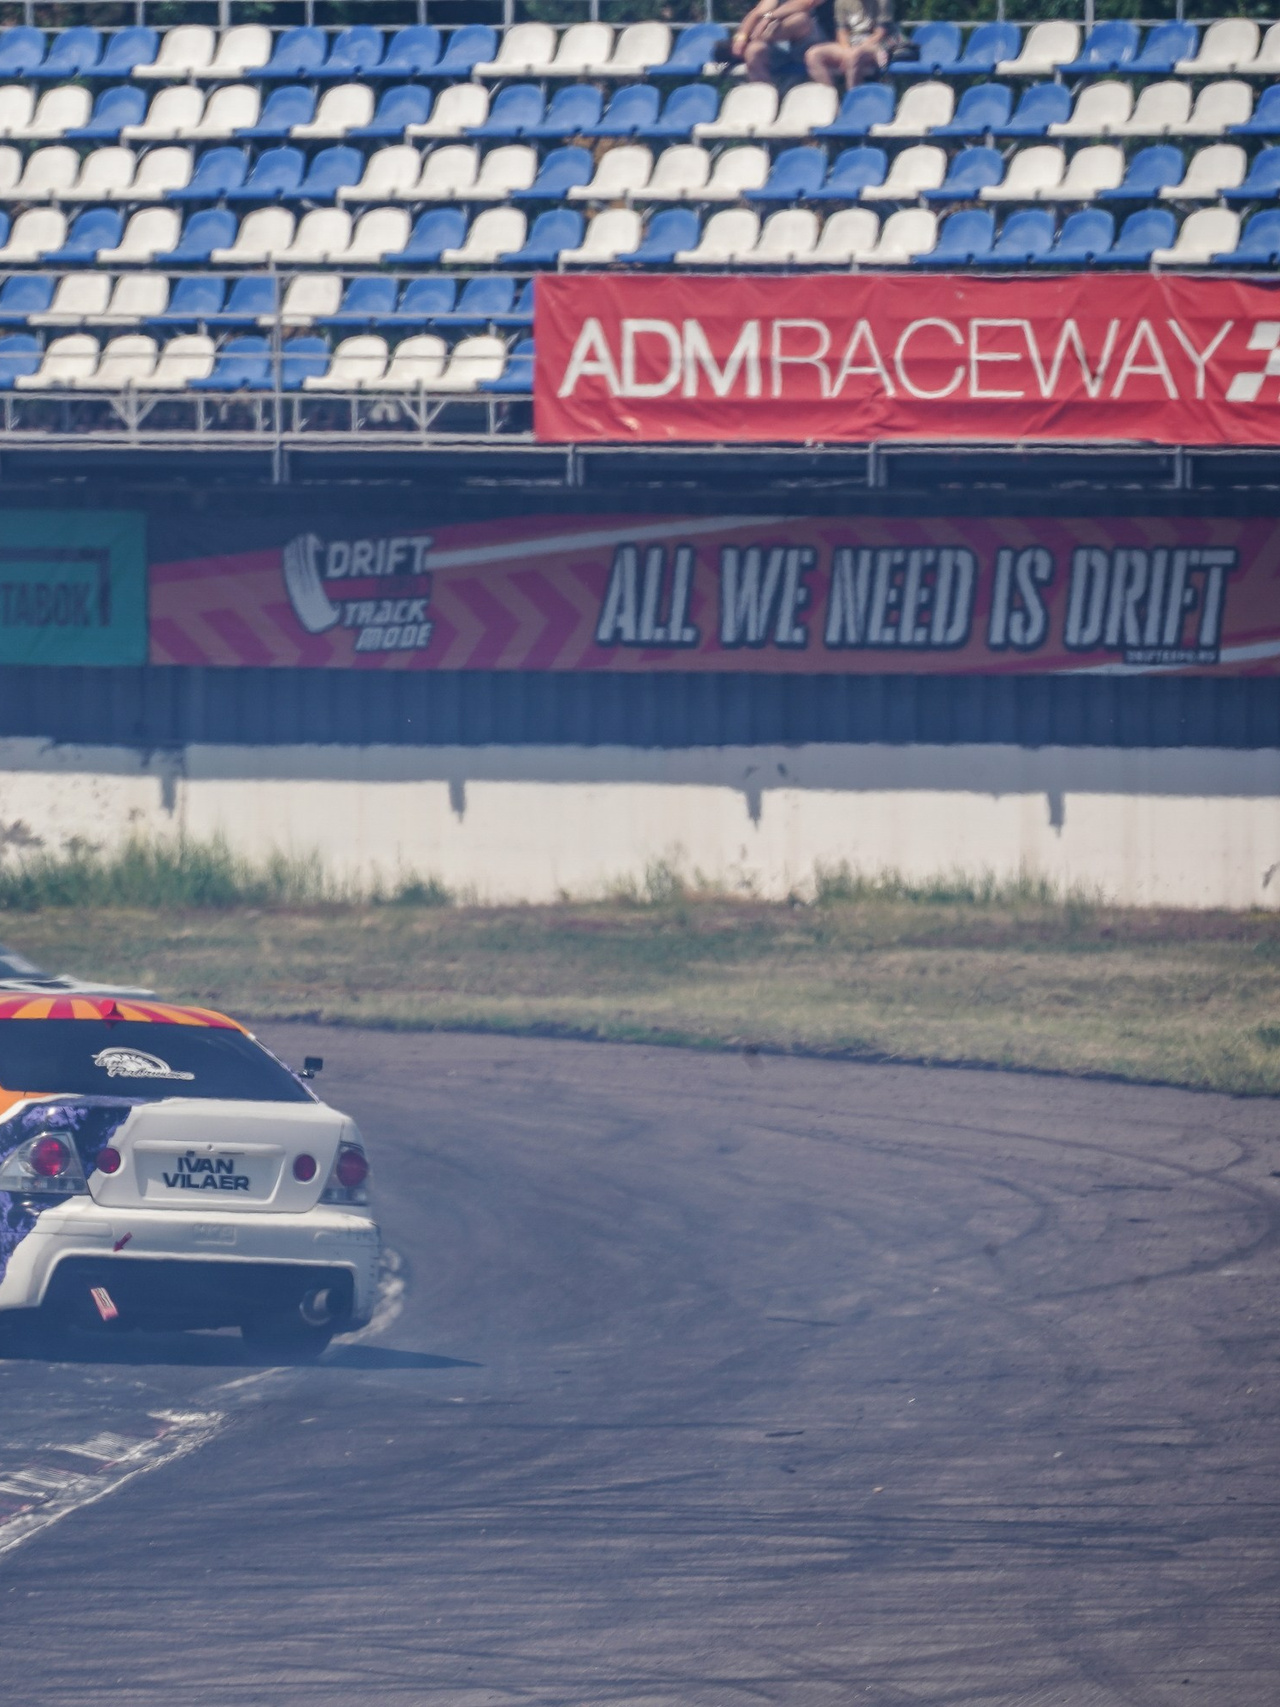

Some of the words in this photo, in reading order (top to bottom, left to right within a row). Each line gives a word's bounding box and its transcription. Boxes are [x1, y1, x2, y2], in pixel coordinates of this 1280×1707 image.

[326, 536, 434, 579] DRIFT
[598, 547, 698, 645] ALL
[720, 547, 816, 645] WE
[826, 547, 975, 646] NEED
[989, 548, 1054, 646] IS
[1065, 549, 1237, 647] DRIFT
[343, 599, 428, 628] TRACK
[355, 622, 433, 651] MODE
[177, 1157, 234, 1174] IVAN
[162, 1172, 250, 1191] VILAER
